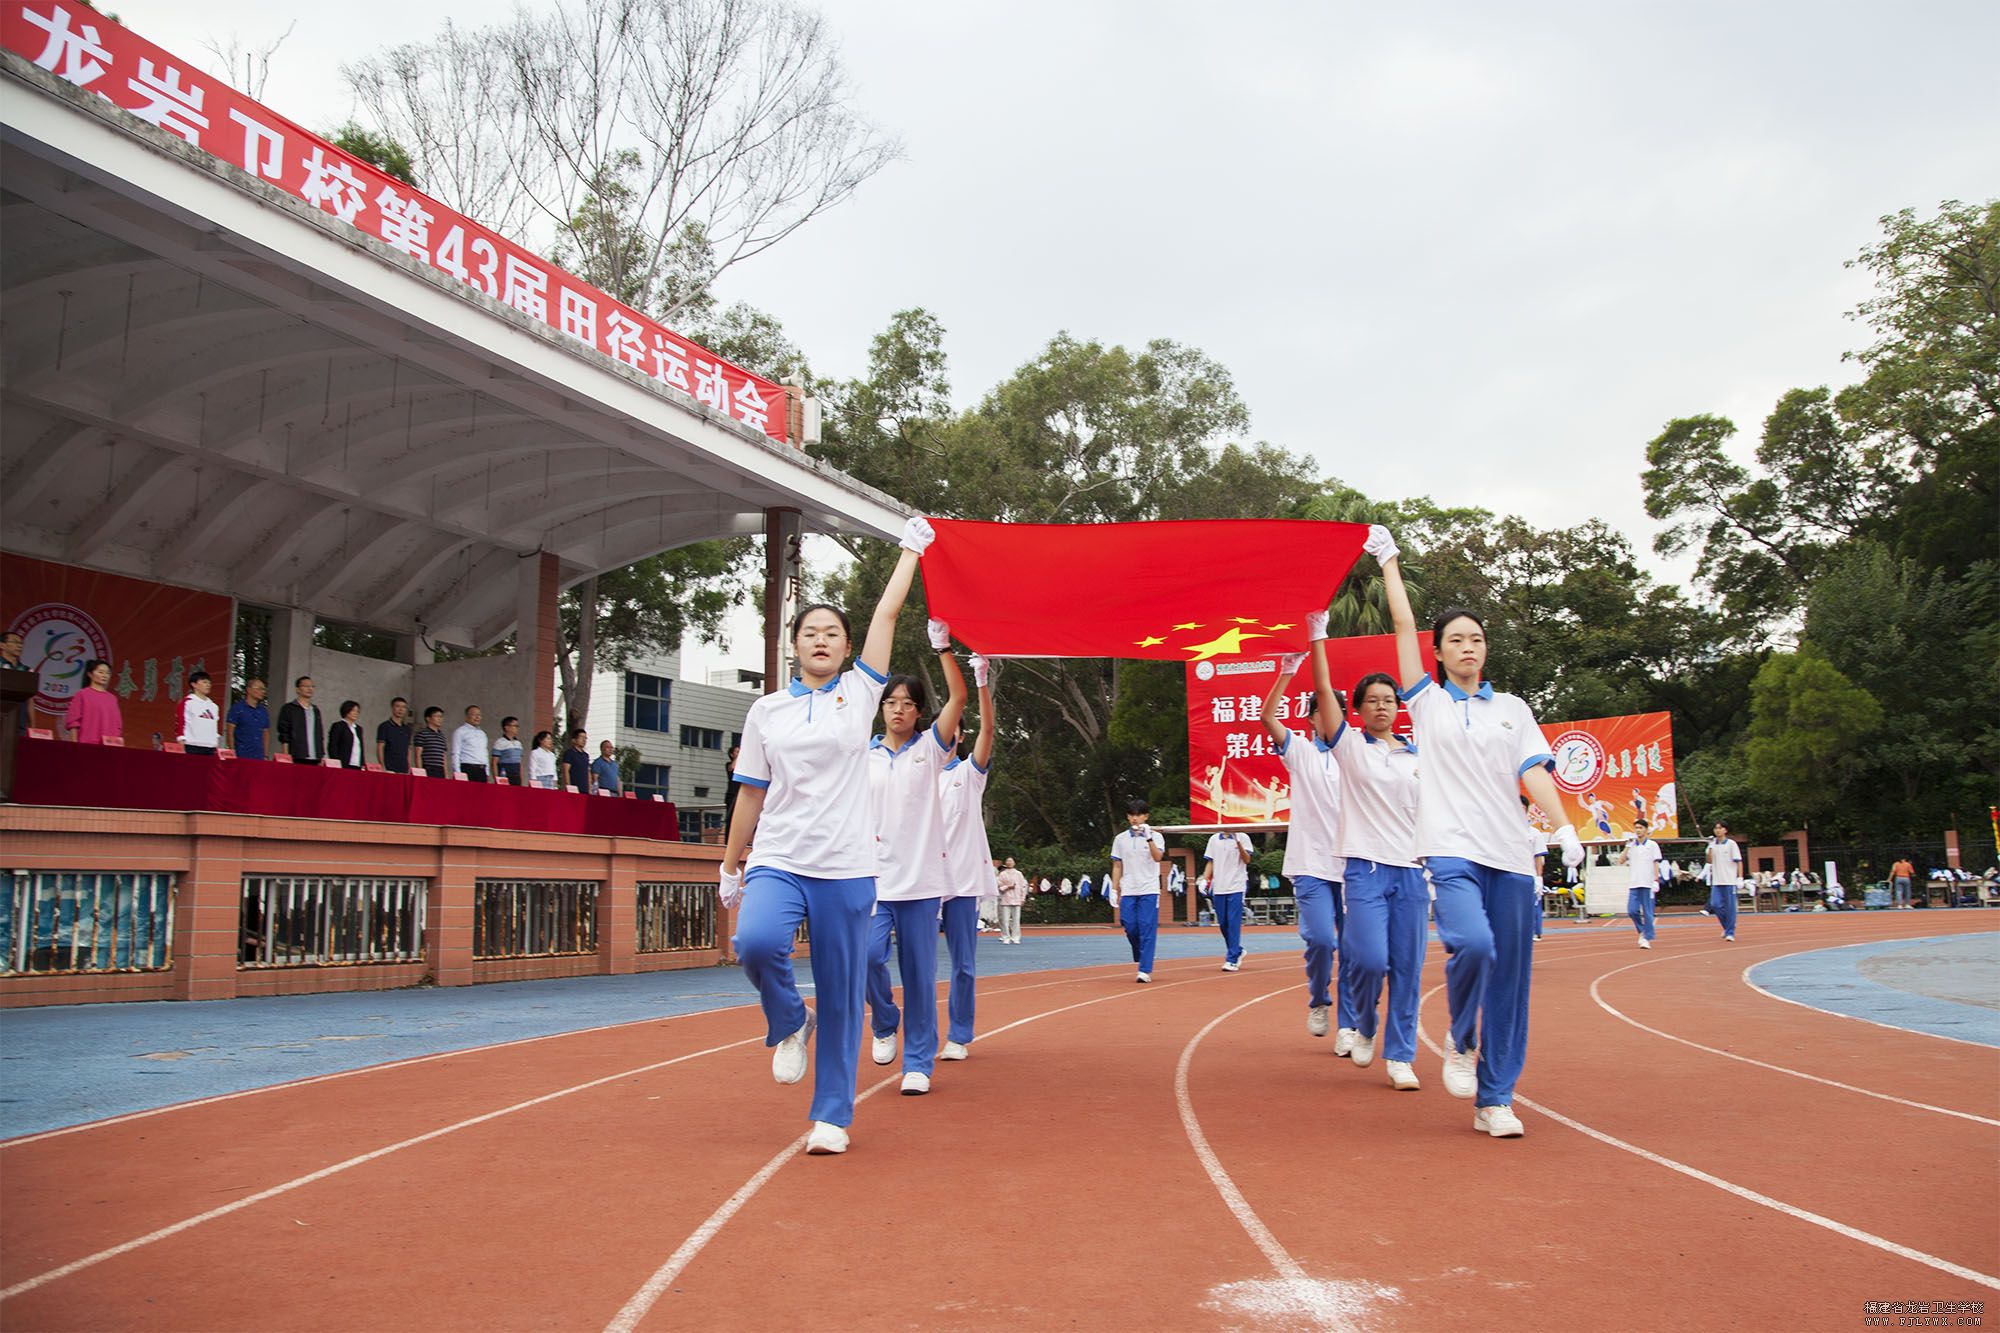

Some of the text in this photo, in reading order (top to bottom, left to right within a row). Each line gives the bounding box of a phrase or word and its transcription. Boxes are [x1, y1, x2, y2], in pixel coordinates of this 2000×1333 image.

[21, 4, 770, 435] 龙岩卫校第43届田径运动会
